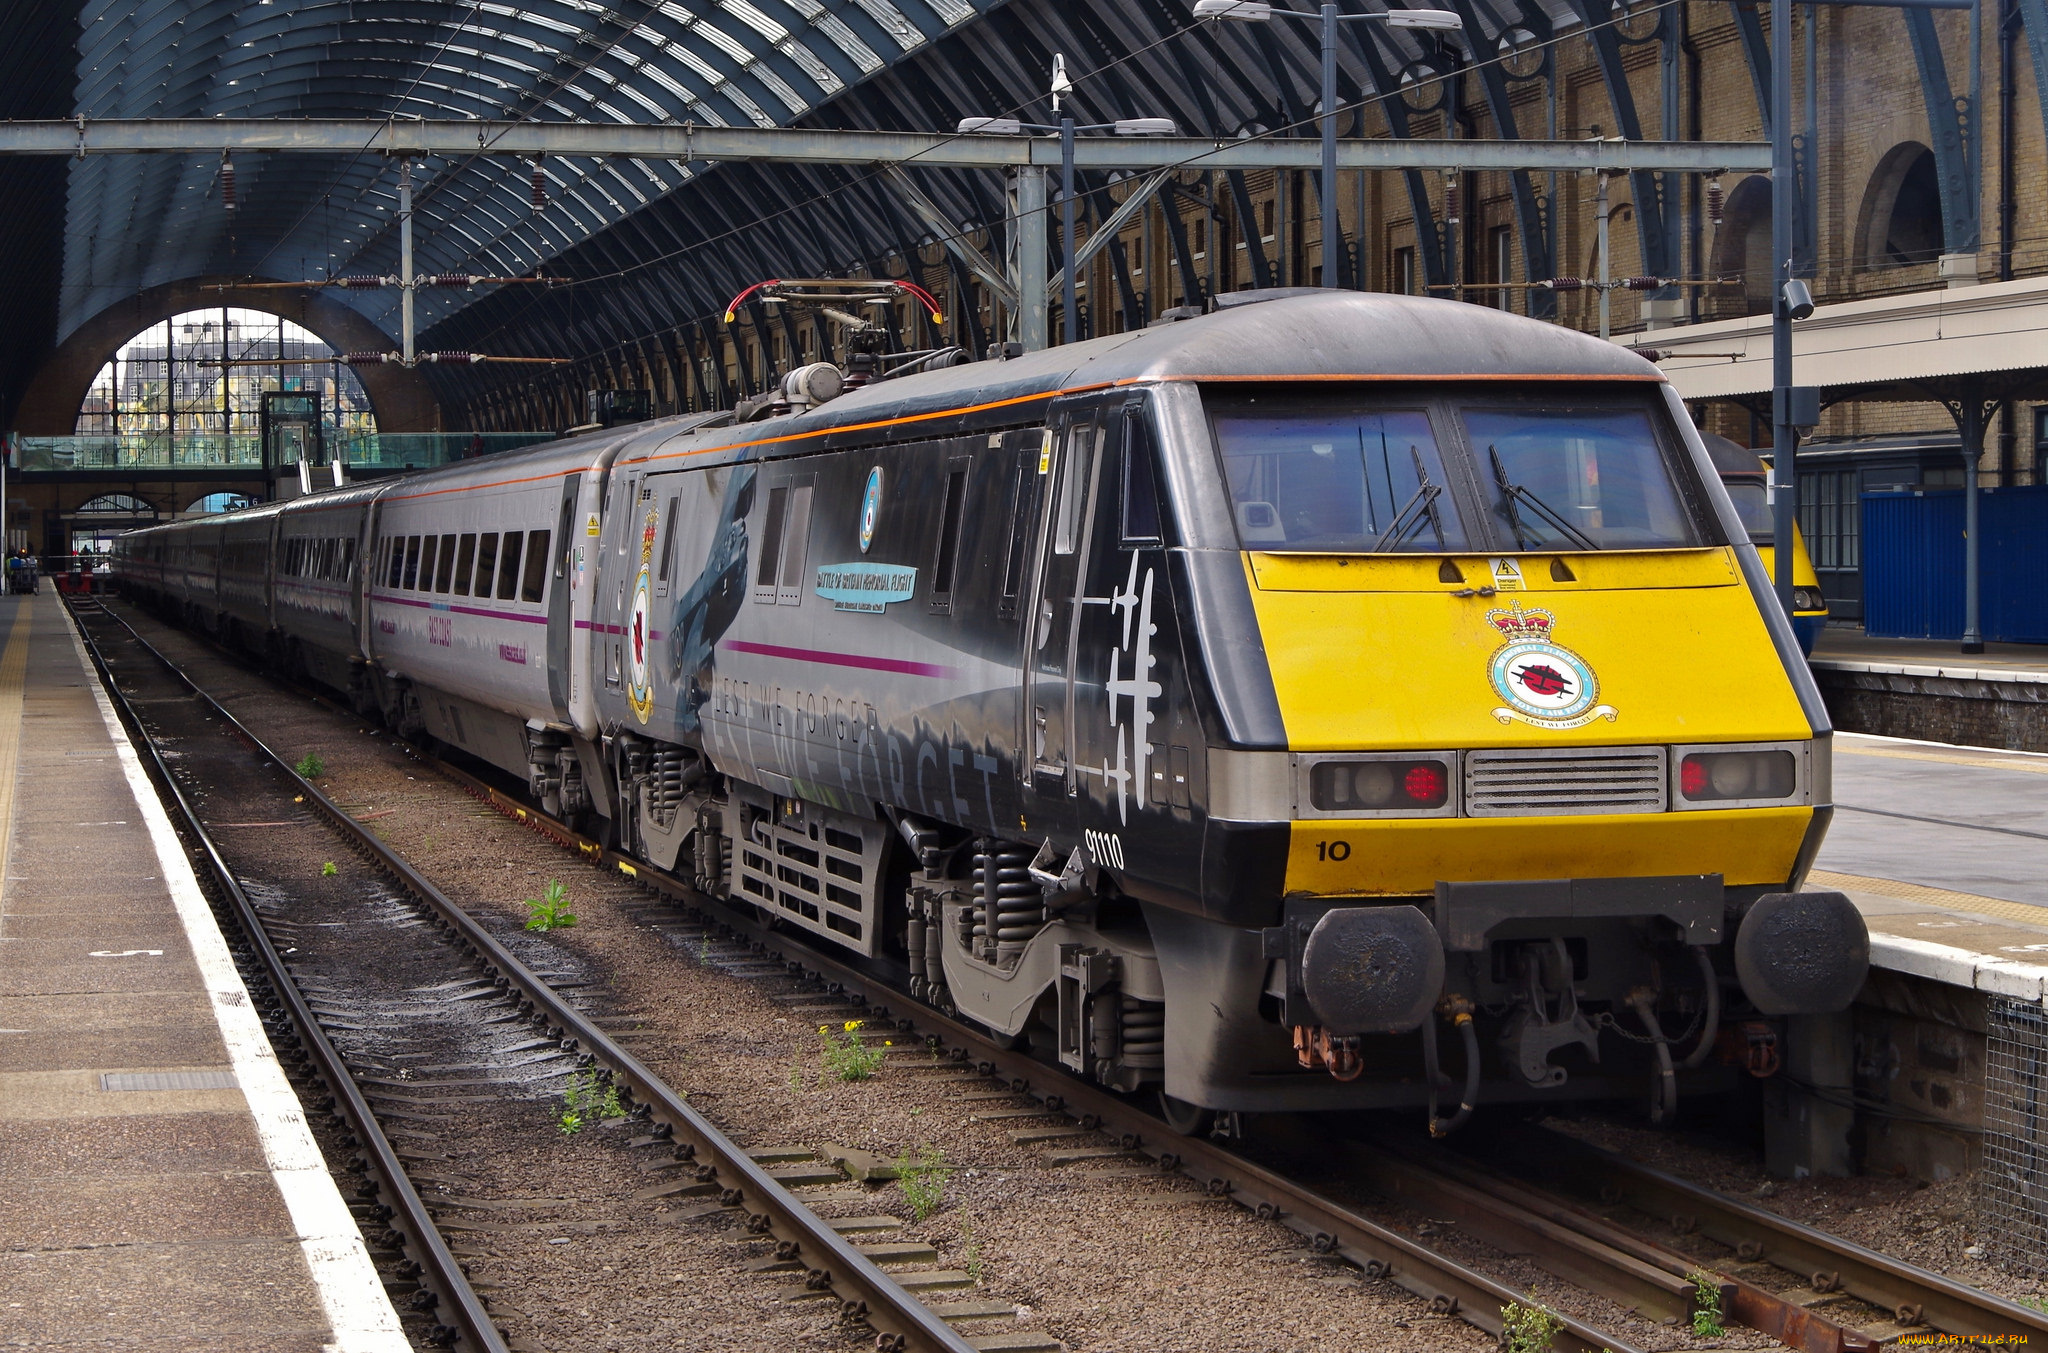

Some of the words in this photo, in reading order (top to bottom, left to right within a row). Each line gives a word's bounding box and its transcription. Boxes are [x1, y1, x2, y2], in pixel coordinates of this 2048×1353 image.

[891, 574, 913, 592] FLIGHT
[1496, 644, 1538, 667] MEMORIAL
[1544, 645, 1578, 666] FLIGHT
[715, 678, 749, 718] LEST
[760, 684, 782, 727] WE
[795, 690, 872, 745] FORGET
[1512, 697, 1543, 716] ROYAL
[1561, 716, 1591, 728] FORGET
[1085, 828, 1124, 871] 91110
[1315, 840, 1351, 862] 10
